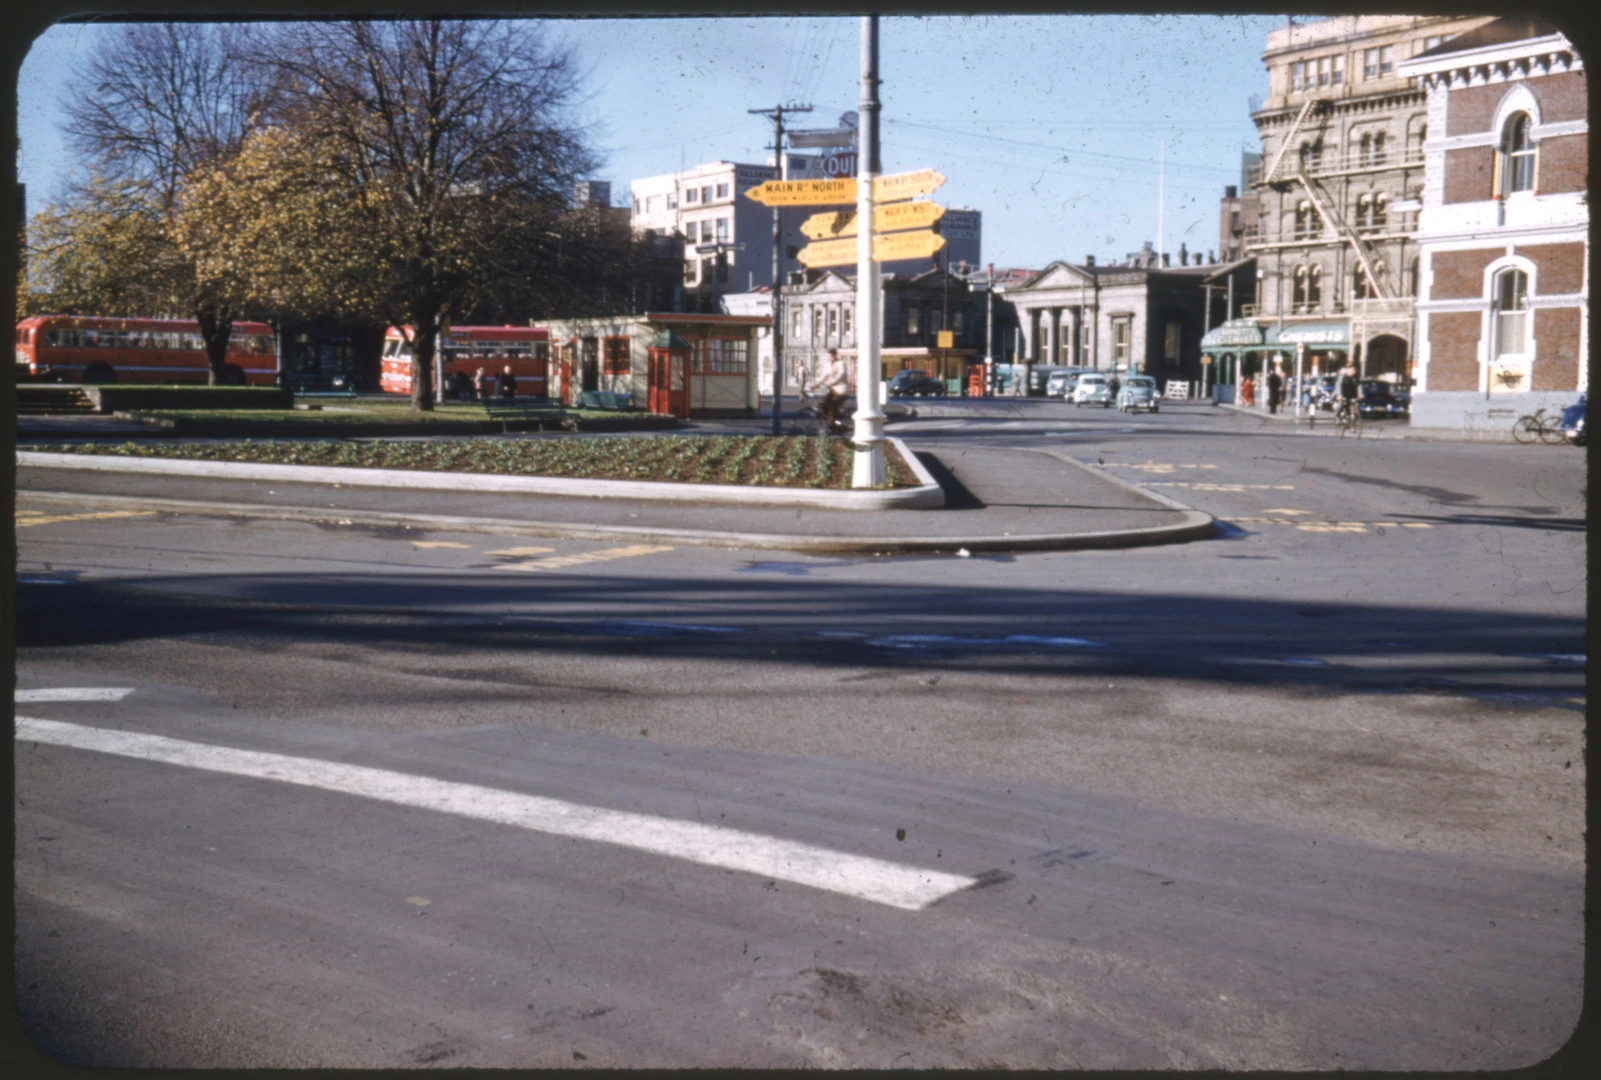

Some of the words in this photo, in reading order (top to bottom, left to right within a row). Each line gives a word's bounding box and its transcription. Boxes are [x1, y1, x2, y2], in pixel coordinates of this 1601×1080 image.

[739, 169, 775, 179] ALLIANC
[766, 183, 793, 194] MAIN
[812, 181, 845, 192] NORTH
[1278, 330, 1343, 342] CHEMISTS
